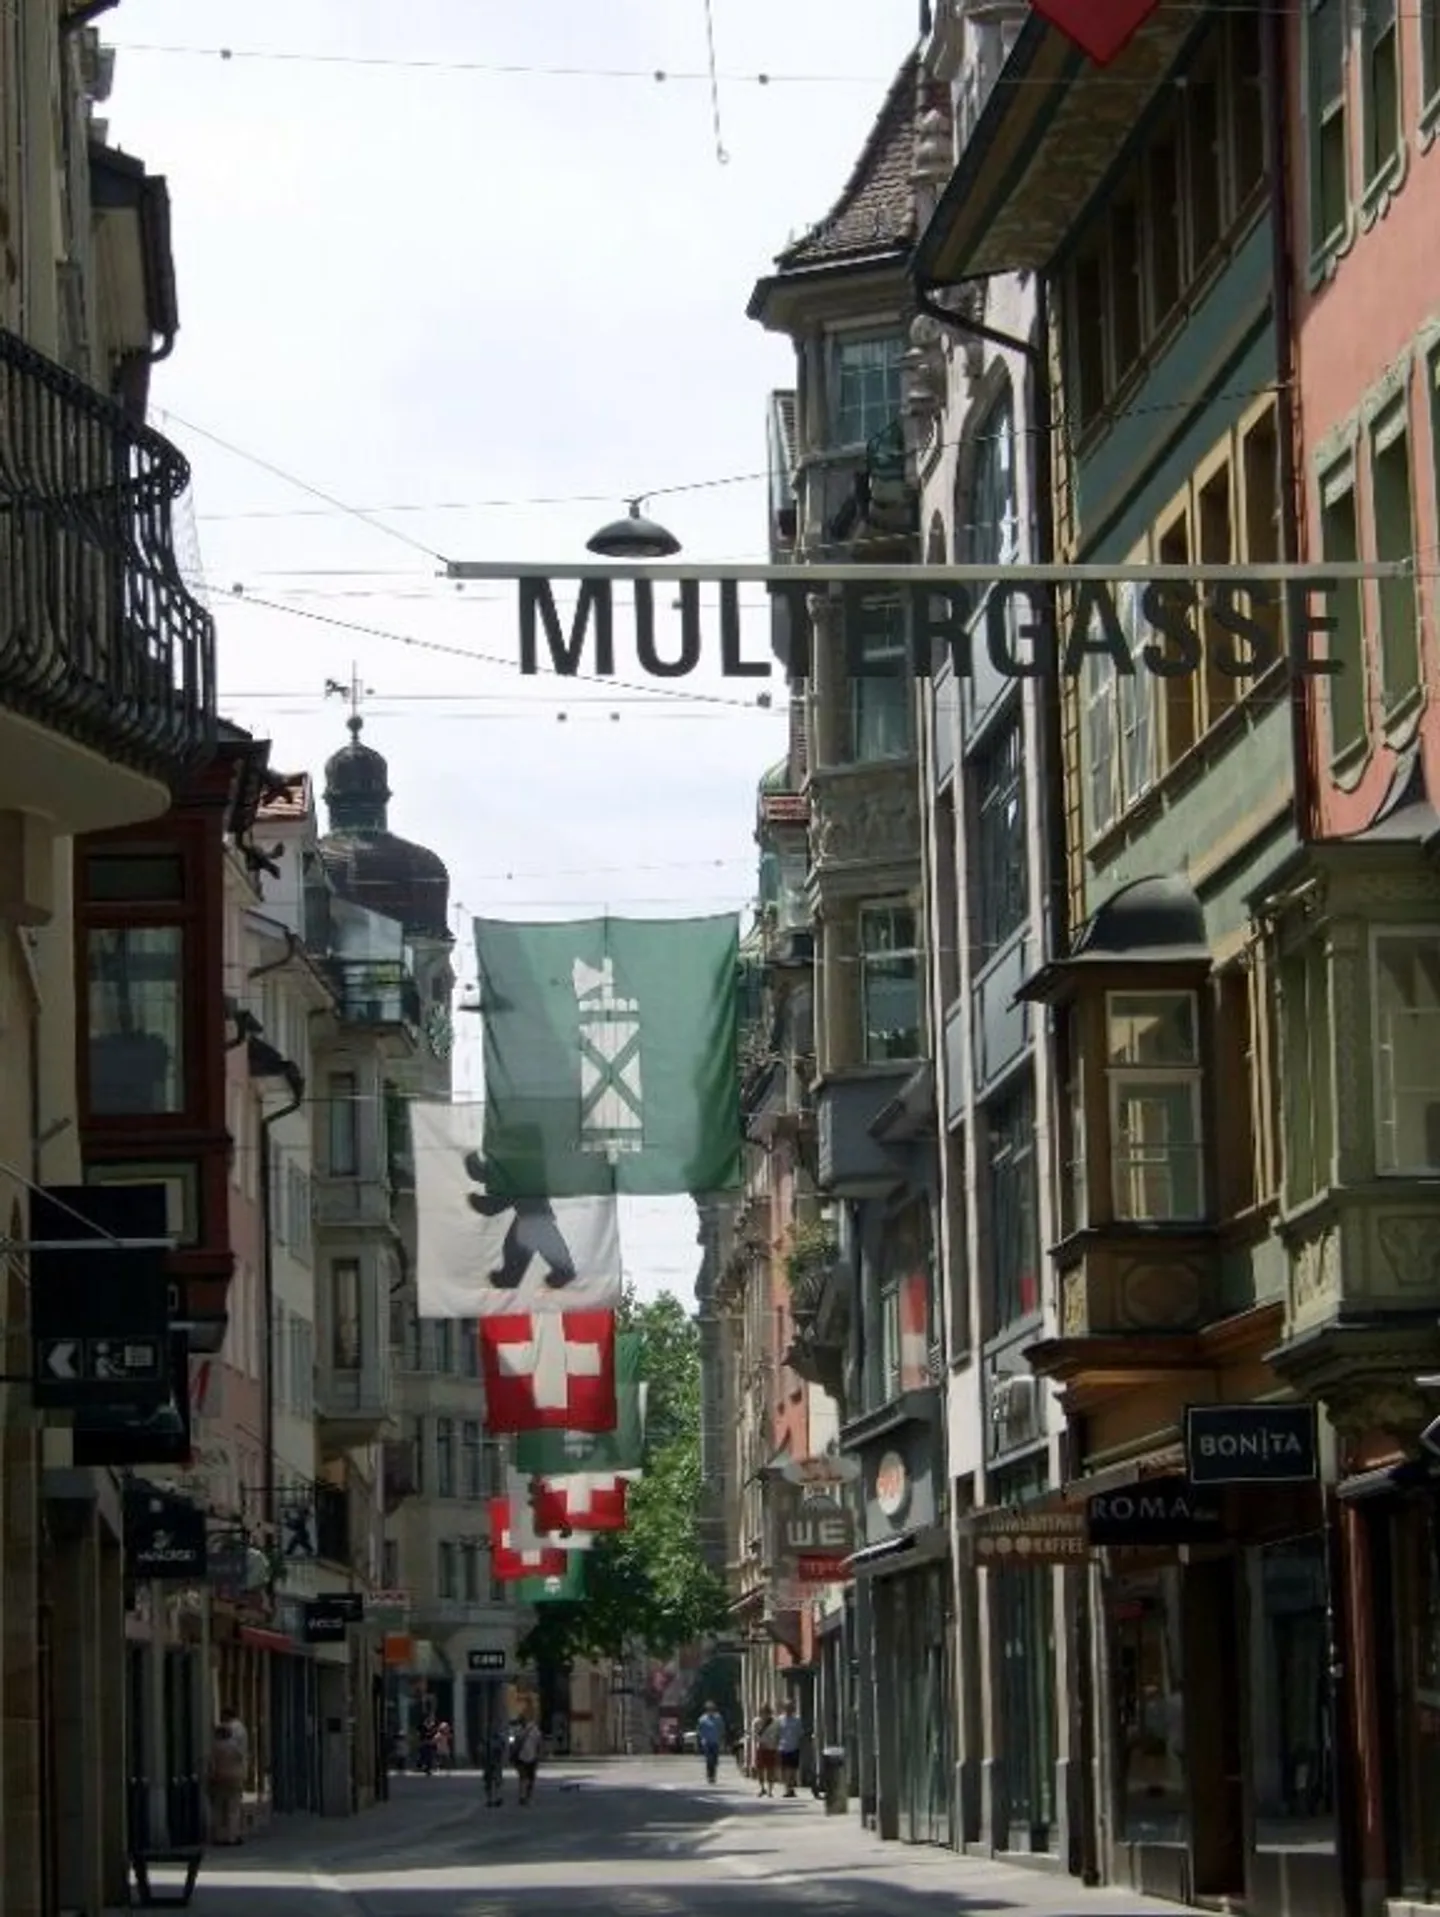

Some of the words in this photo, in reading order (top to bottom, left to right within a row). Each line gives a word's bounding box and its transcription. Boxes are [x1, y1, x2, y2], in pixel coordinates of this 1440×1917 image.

[519, 578, 1345, 677] MULTERGASSE
[1199, 1426, 1302, 1461] BONITA
[1091, 1496, 1191, 1520] ROMA
